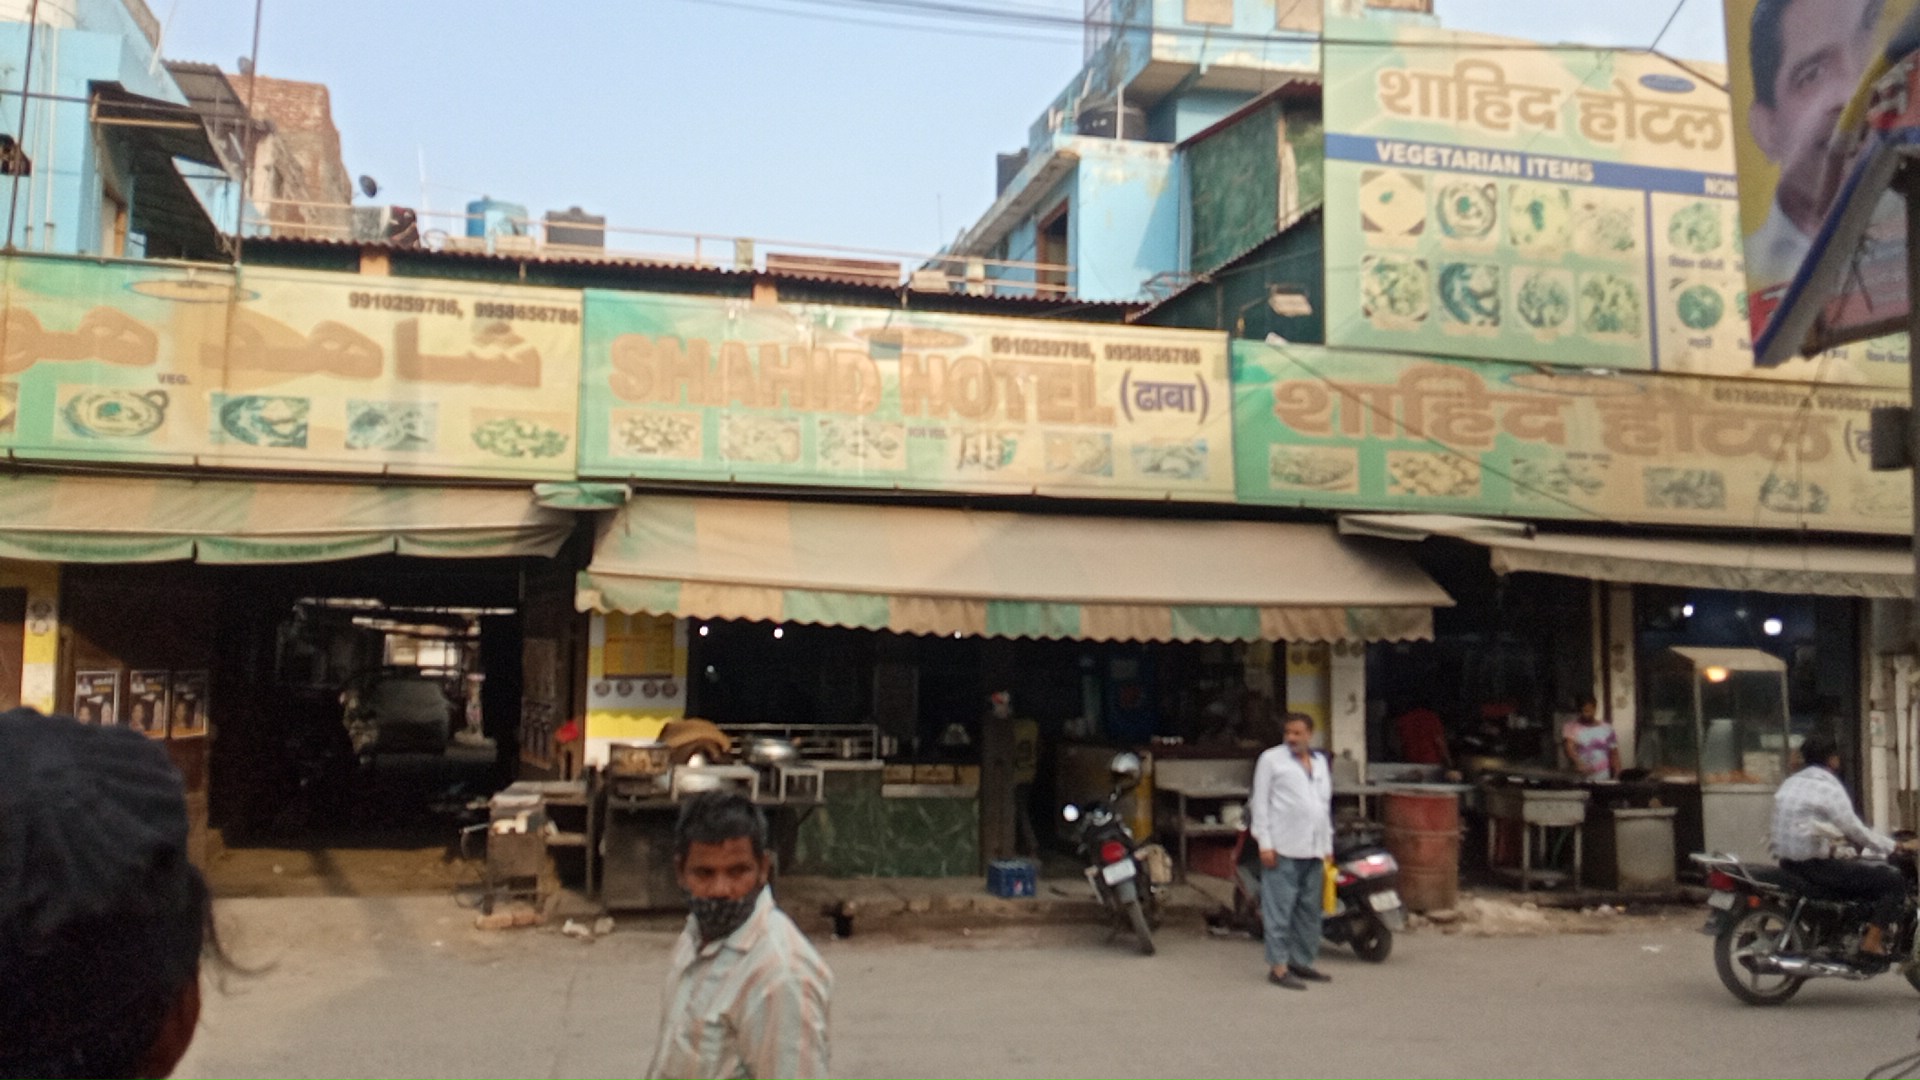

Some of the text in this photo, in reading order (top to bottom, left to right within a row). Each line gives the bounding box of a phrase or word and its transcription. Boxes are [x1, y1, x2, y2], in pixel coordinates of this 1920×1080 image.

[1379, 58, 1728, 150] शाहिद होटल
[1376, 141, 1595, 183] VEGETARIAN ITEMS
[608, 333, 1119, 426] SHAHID HOTEL
[1120, 367, 1210, 425] (ढाबा)
[1274, 363, 1573, 448] शाहिद
[1596, 382, 1836, 464] होटल
